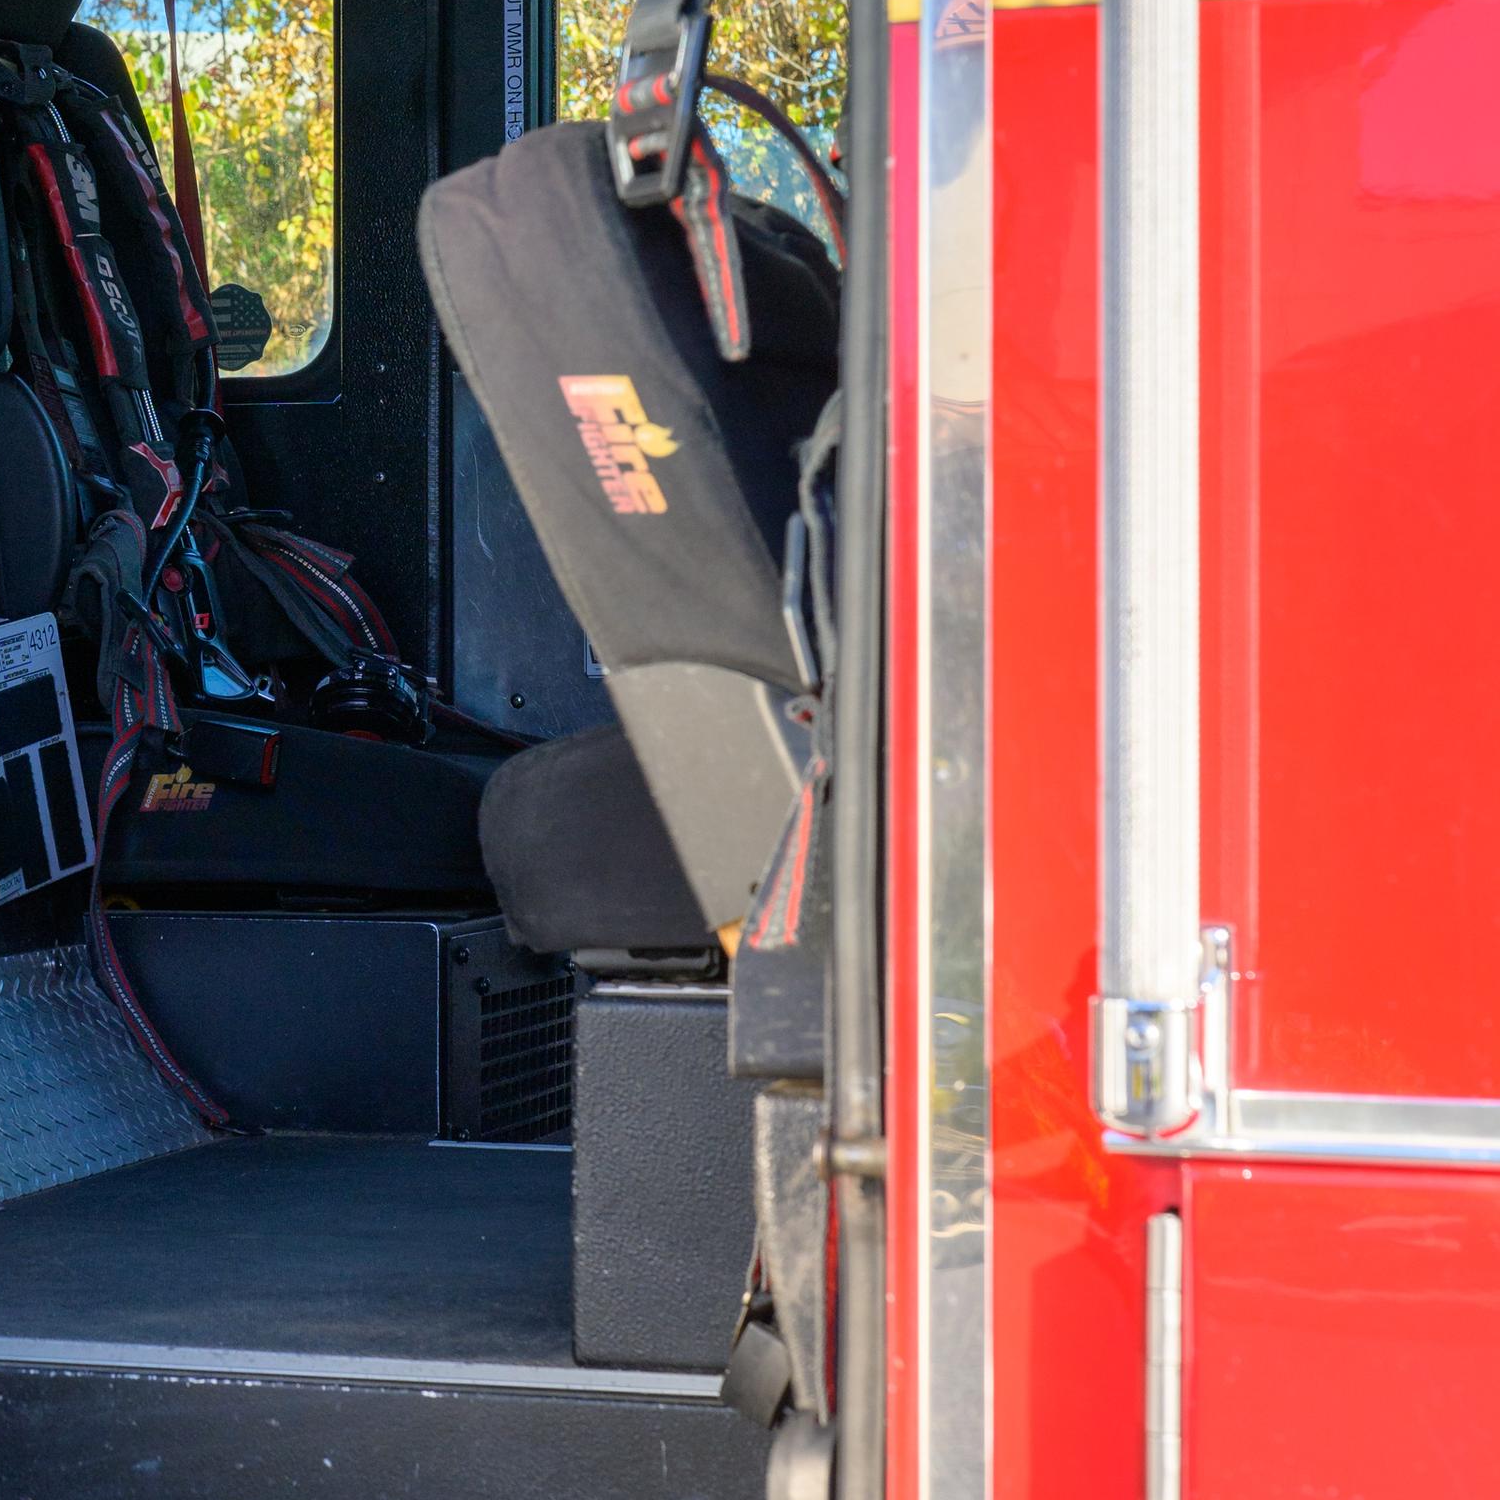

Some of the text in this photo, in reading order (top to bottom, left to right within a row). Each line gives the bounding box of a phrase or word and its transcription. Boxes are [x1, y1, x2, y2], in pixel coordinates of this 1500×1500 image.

[506, 23, 522, 68] MMR
[506, 75, 522, 103] ON
[506, 112, 522, 140] HO
[66, 153, 100, 224] 3M
[100, 280, 142, 363] SCOTT
[29, 624, 57, 650] 4312
[141, 766, 216, 801] Fire
